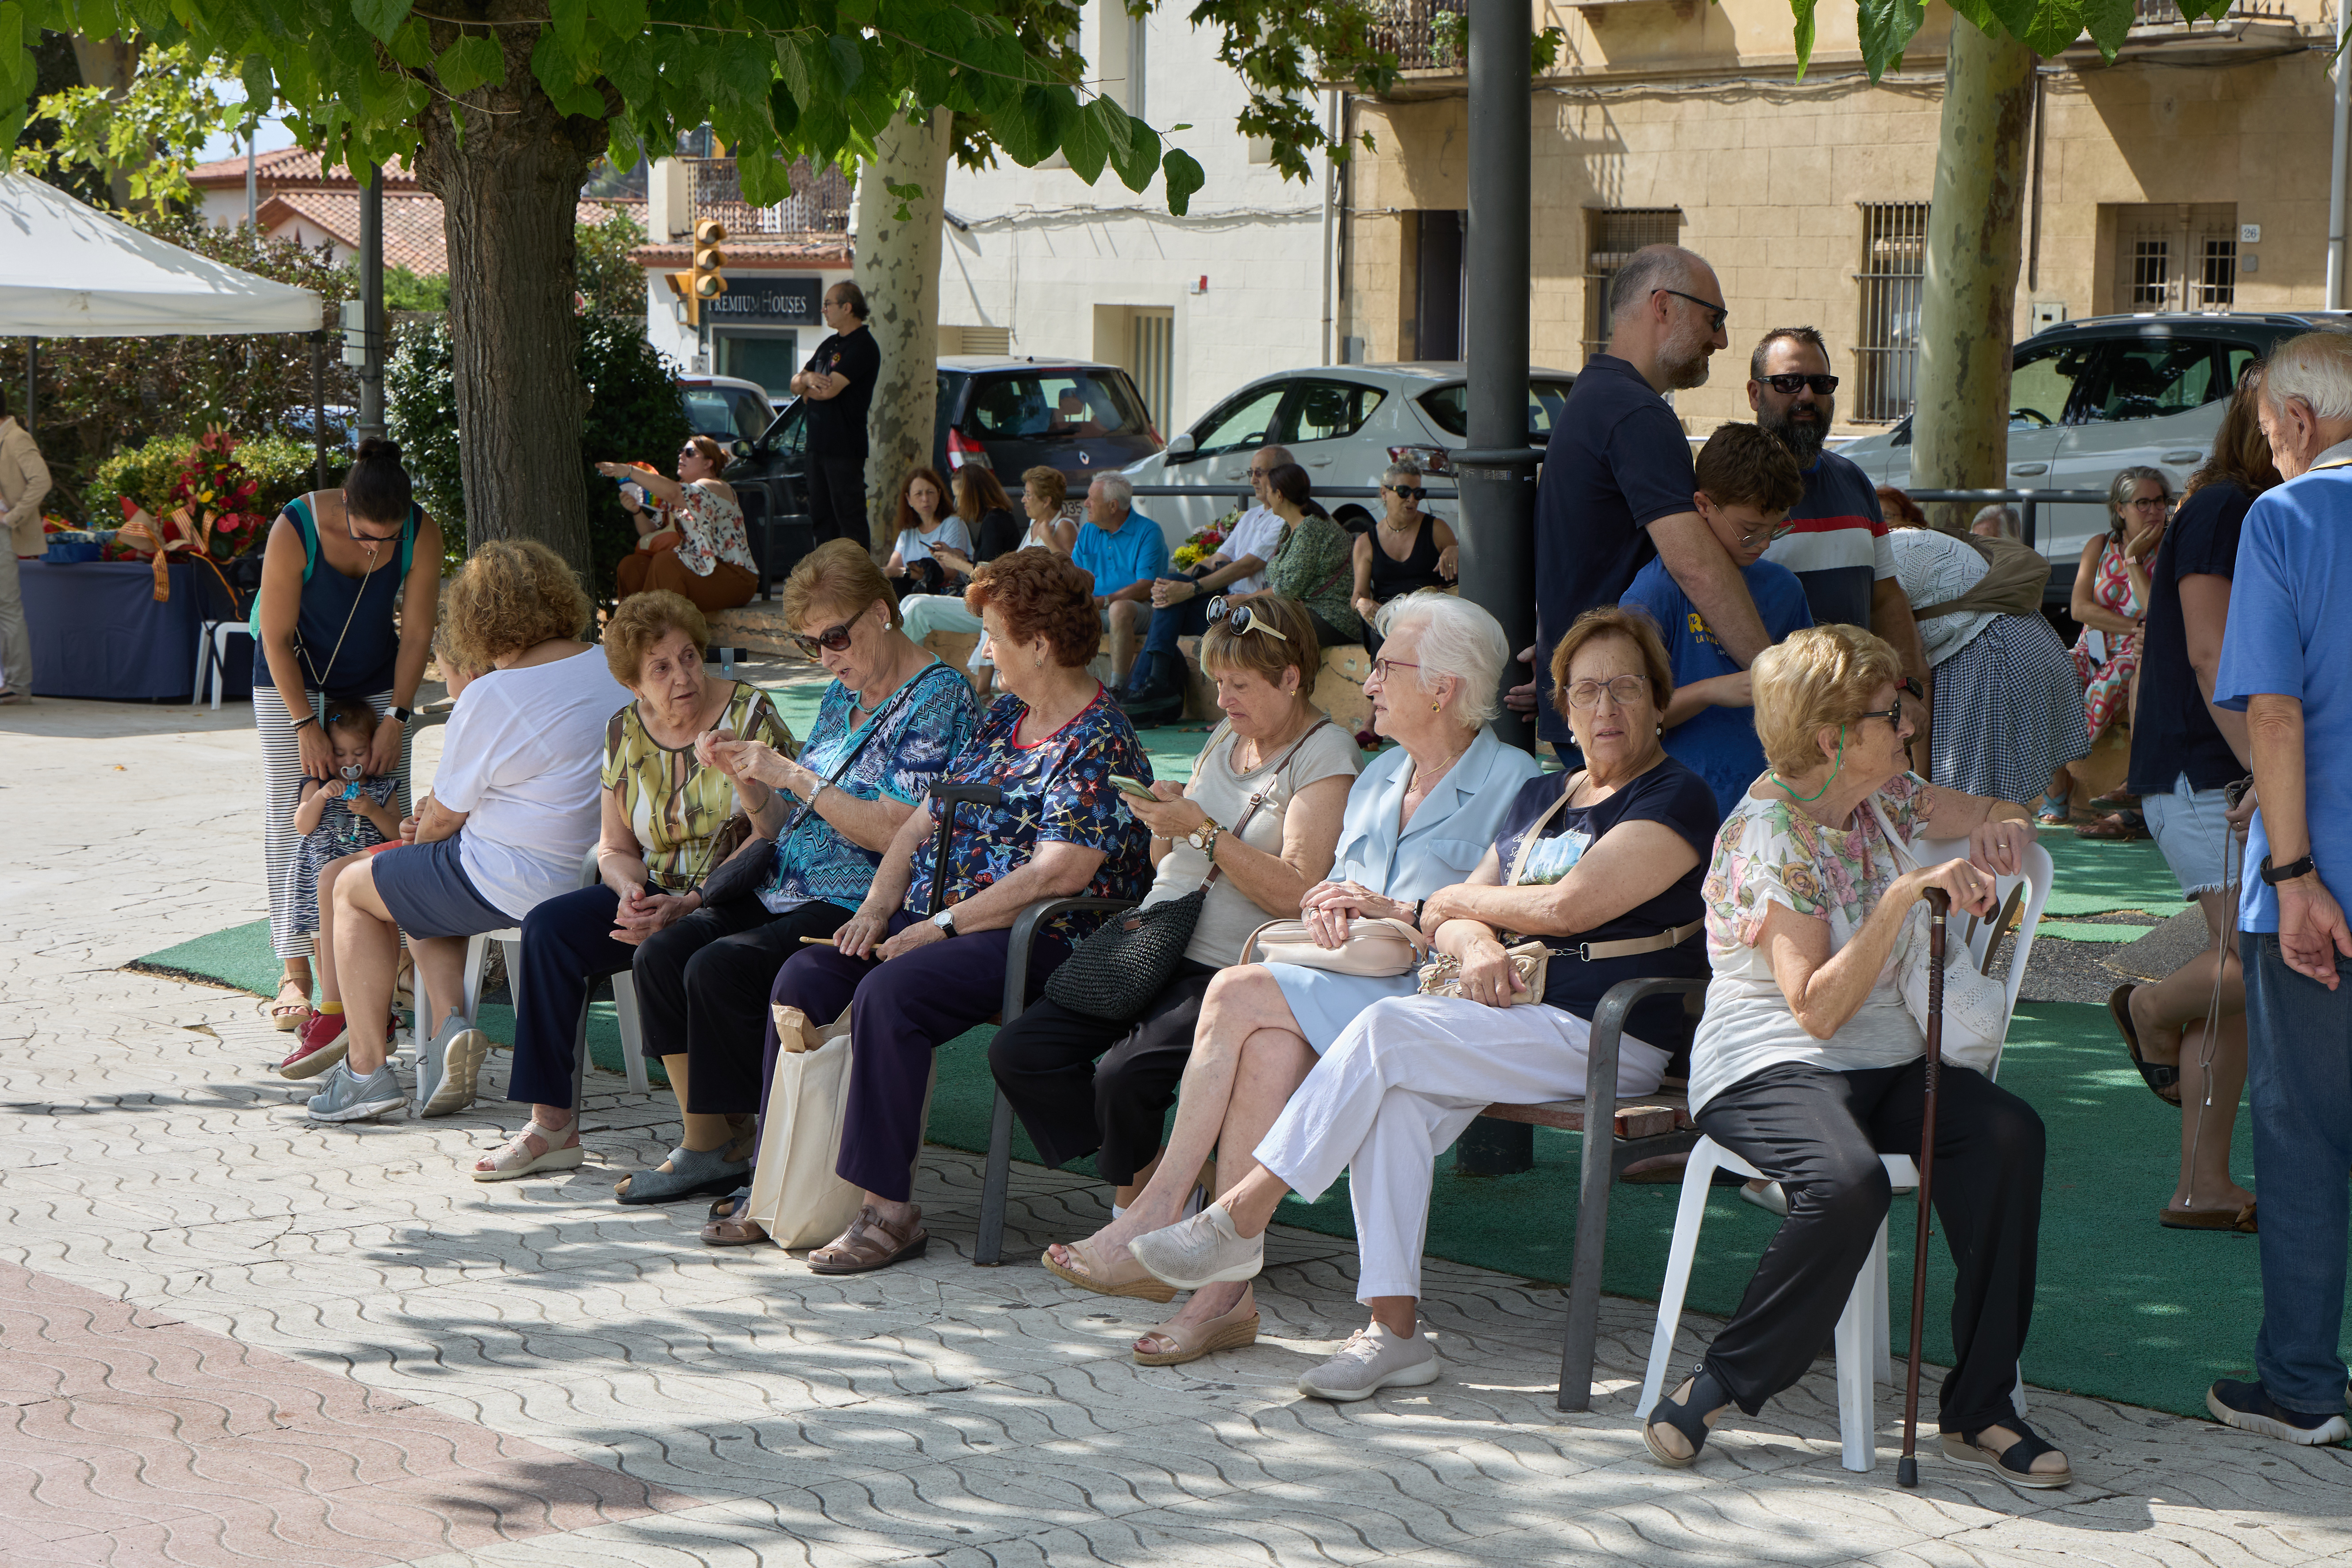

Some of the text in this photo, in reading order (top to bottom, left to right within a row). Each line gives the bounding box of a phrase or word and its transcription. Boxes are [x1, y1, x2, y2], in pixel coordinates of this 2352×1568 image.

[2244, 228, 2257, 239] 26
[761, 290, 807, 313] HOUSES
[1696, 634, 1704, 643] LA
[339, 1091, 354, 1107] FILA
